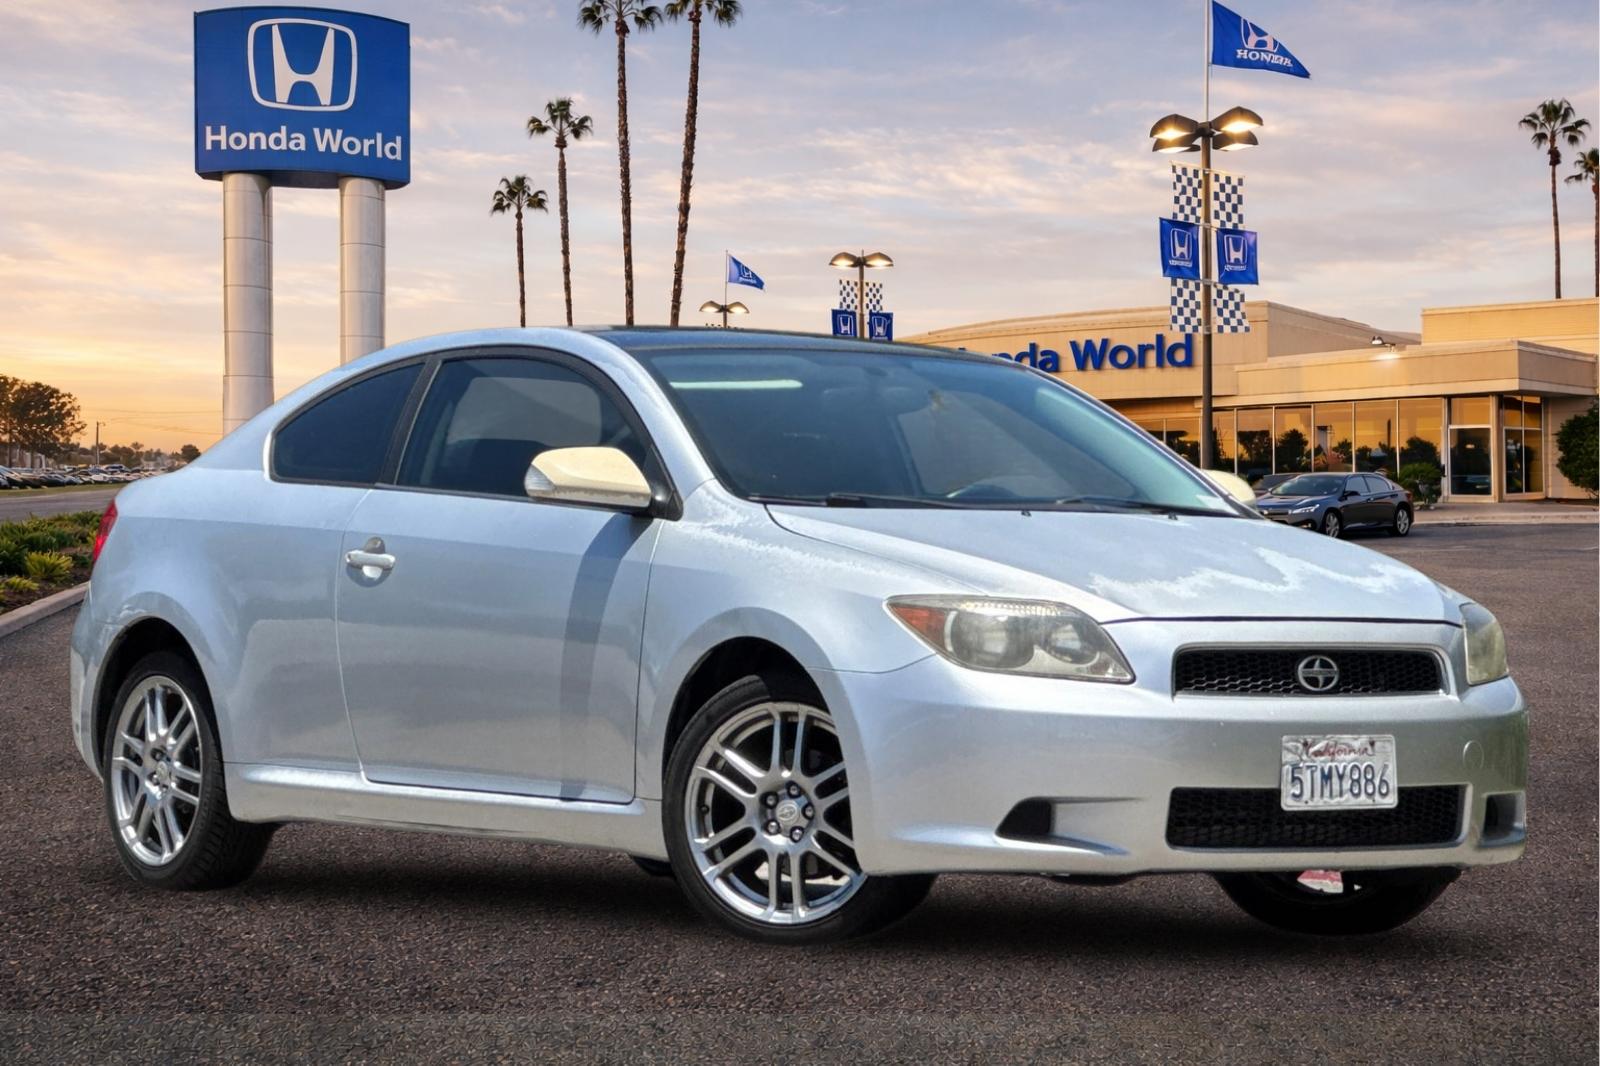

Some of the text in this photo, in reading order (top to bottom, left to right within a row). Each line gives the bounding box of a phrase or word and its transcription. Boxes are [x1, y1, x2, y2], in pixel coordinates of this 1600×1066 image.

[205, 125, 402, 161] Honda World
[1070, 333, 1193, 371] World
[1290, 763, 1390, 801] 5TMY886
